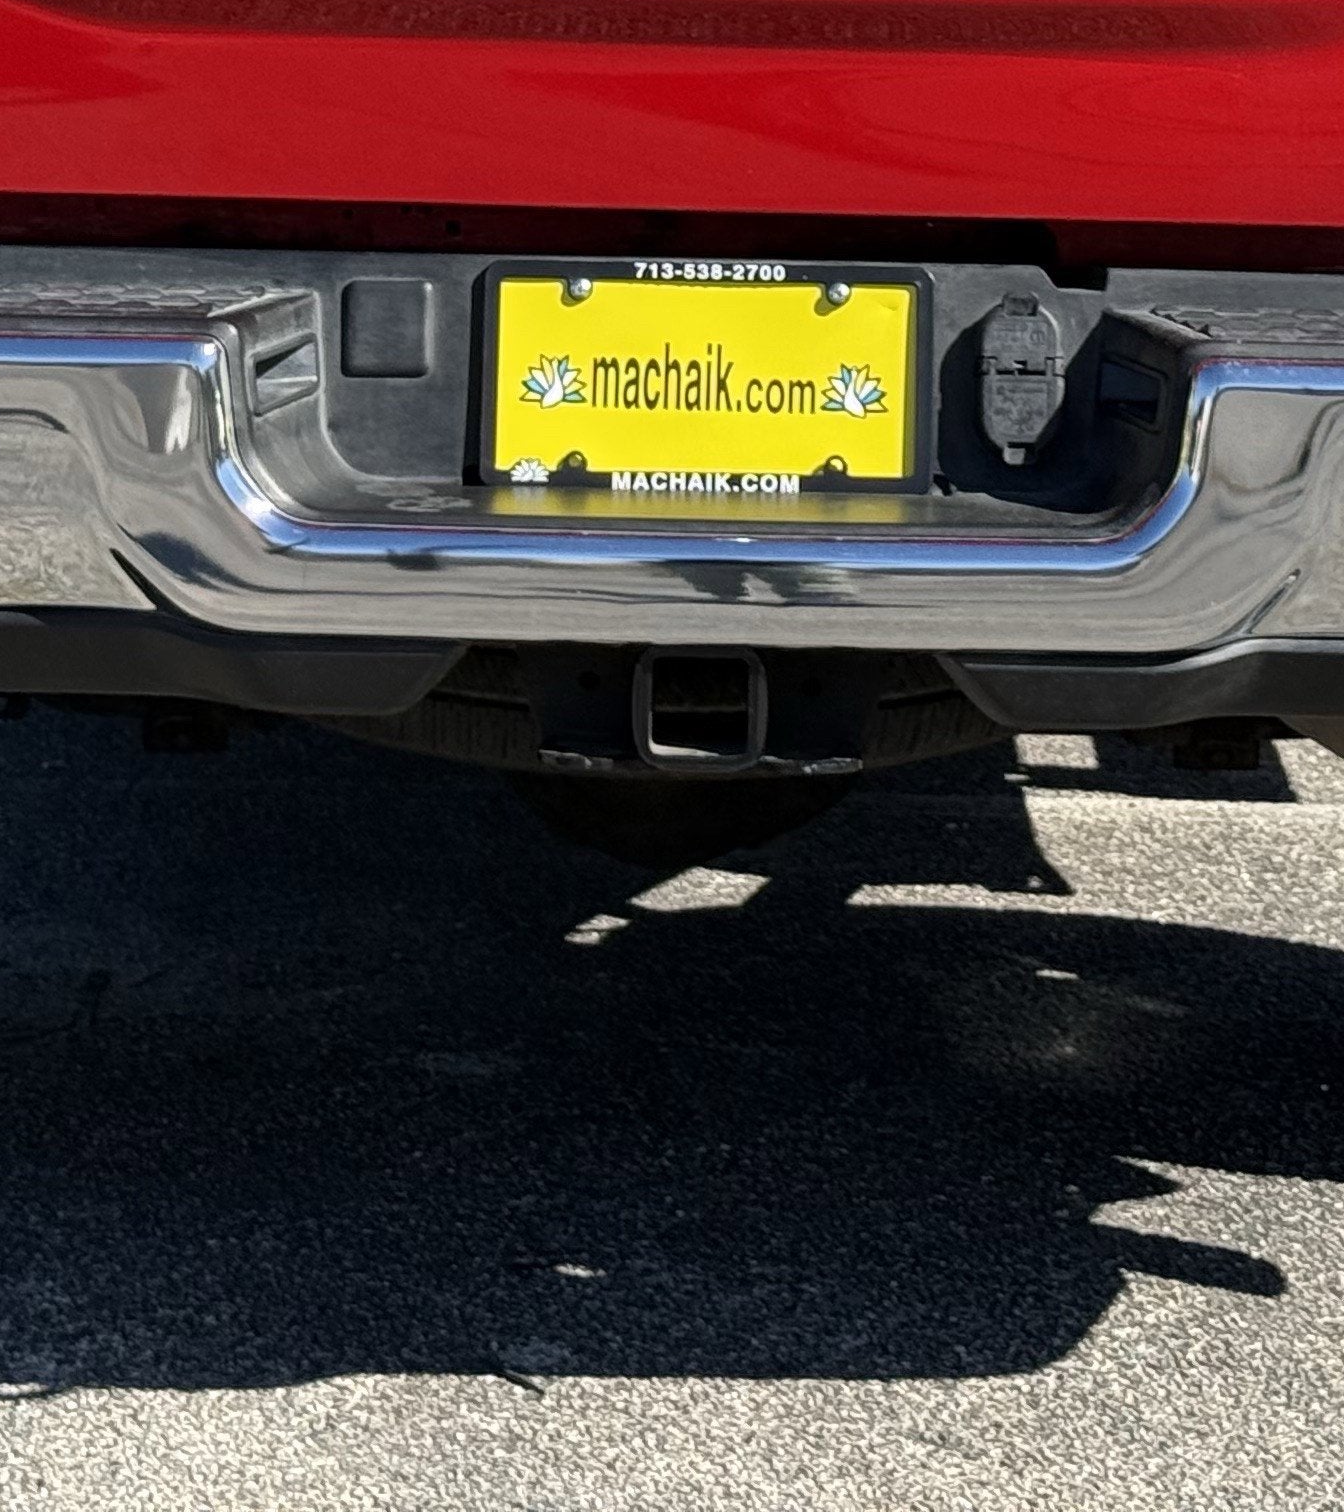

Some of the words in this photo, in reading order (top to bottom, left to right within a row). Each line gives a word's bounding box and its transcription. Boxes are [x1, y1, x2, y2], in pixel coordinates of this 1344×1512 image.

[634, 261, 786, 282] 713-538-2700
[590, 342, 817, 415] machaik.com
[611, 470, 800, 494] MACHAIK.COM
